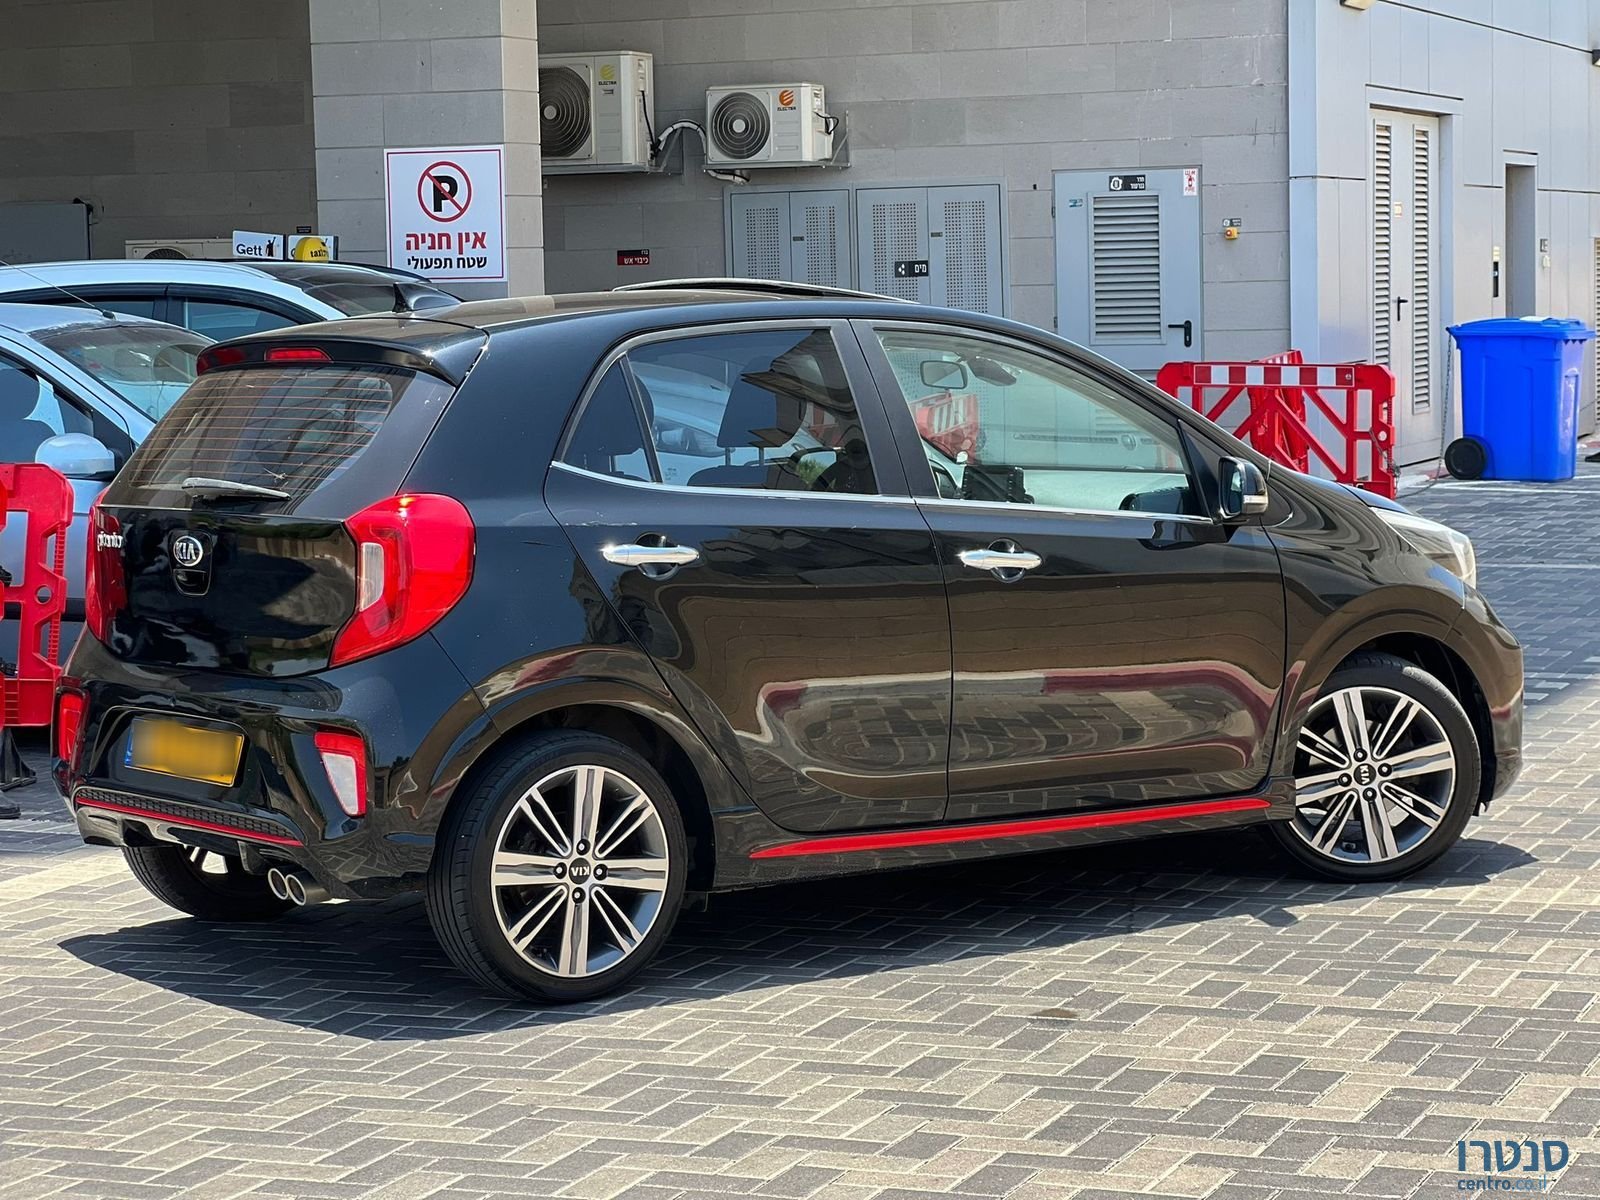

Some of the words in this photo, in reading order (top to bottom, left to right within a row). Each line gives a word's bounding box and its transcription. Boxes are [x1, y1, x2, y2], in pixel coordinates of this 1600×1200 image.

[405, 232, 452, 251] חניה
[458, 231, 487, 255] אין
[236, 243, 263, 257] Gett
[407, 256, 453, 270] תפעולי
[456, 256, 488, 269] שטח
[623, 257, 634, 265] אש
[914, 264, 927, 273] מים
[175, 541, 197, 560] KIA
[1359, 765, 1370, 785] KIA
[570, 865, 590, 877] KIA
